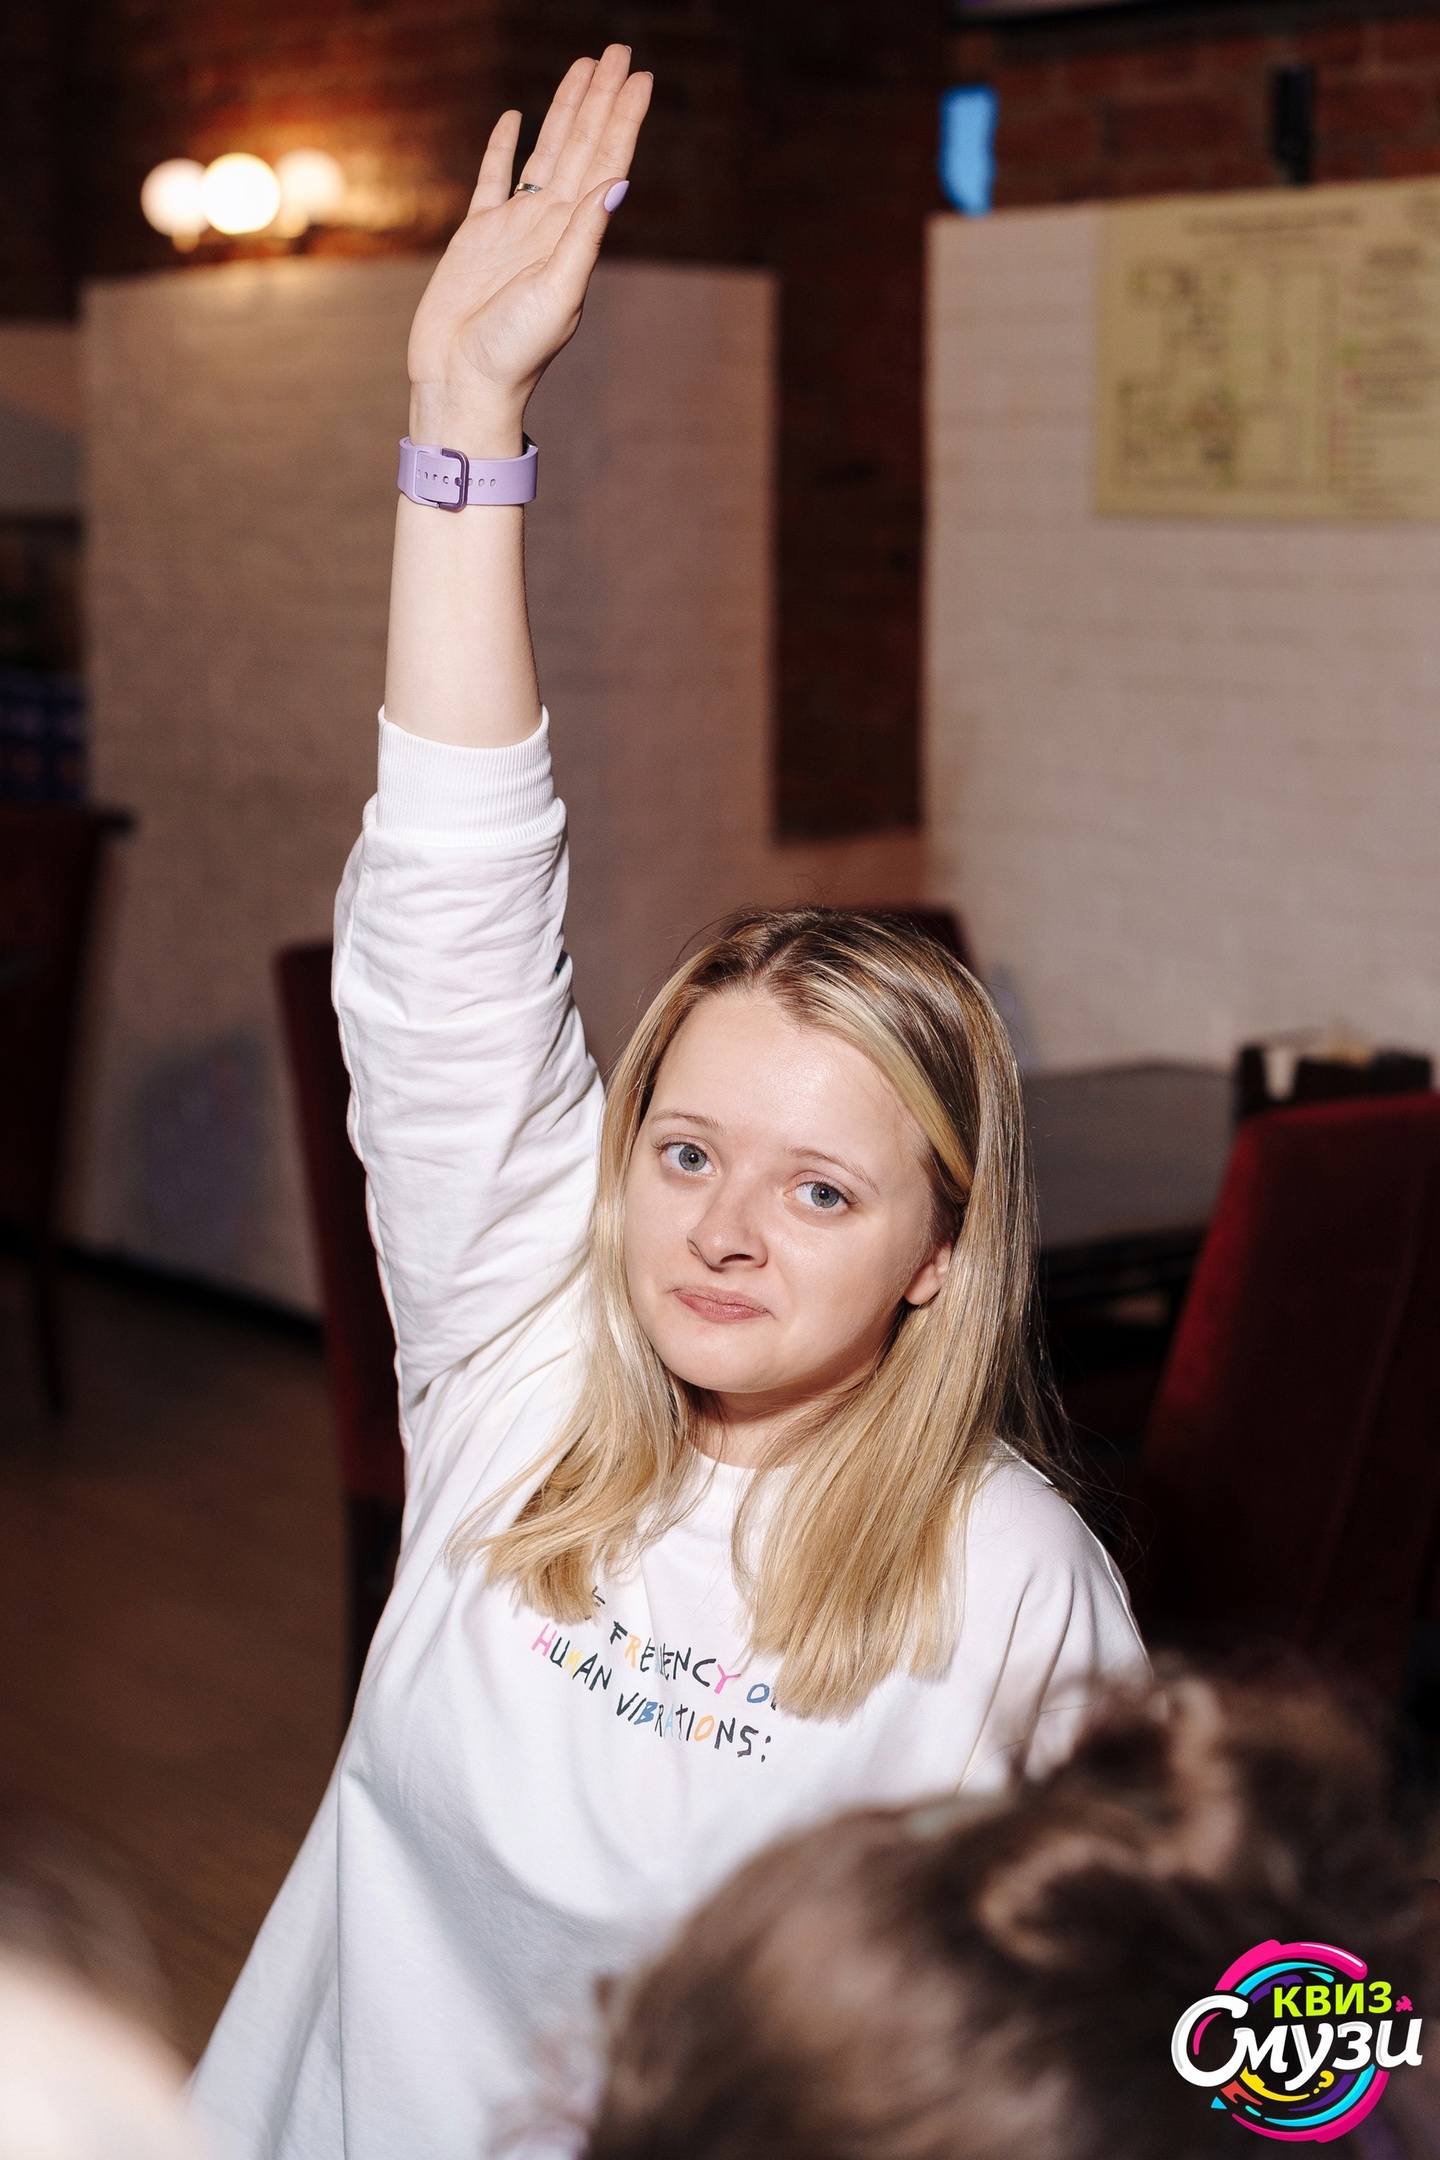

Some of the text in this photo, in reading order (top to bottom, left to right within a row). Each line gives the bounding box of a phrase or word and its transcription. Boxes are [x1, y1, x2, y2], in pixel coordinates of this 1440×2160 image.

[531, 1622, 771, 1762] HUMAN VIBRATIONS:
[609, 1620, 741, 1694] FREENCY
